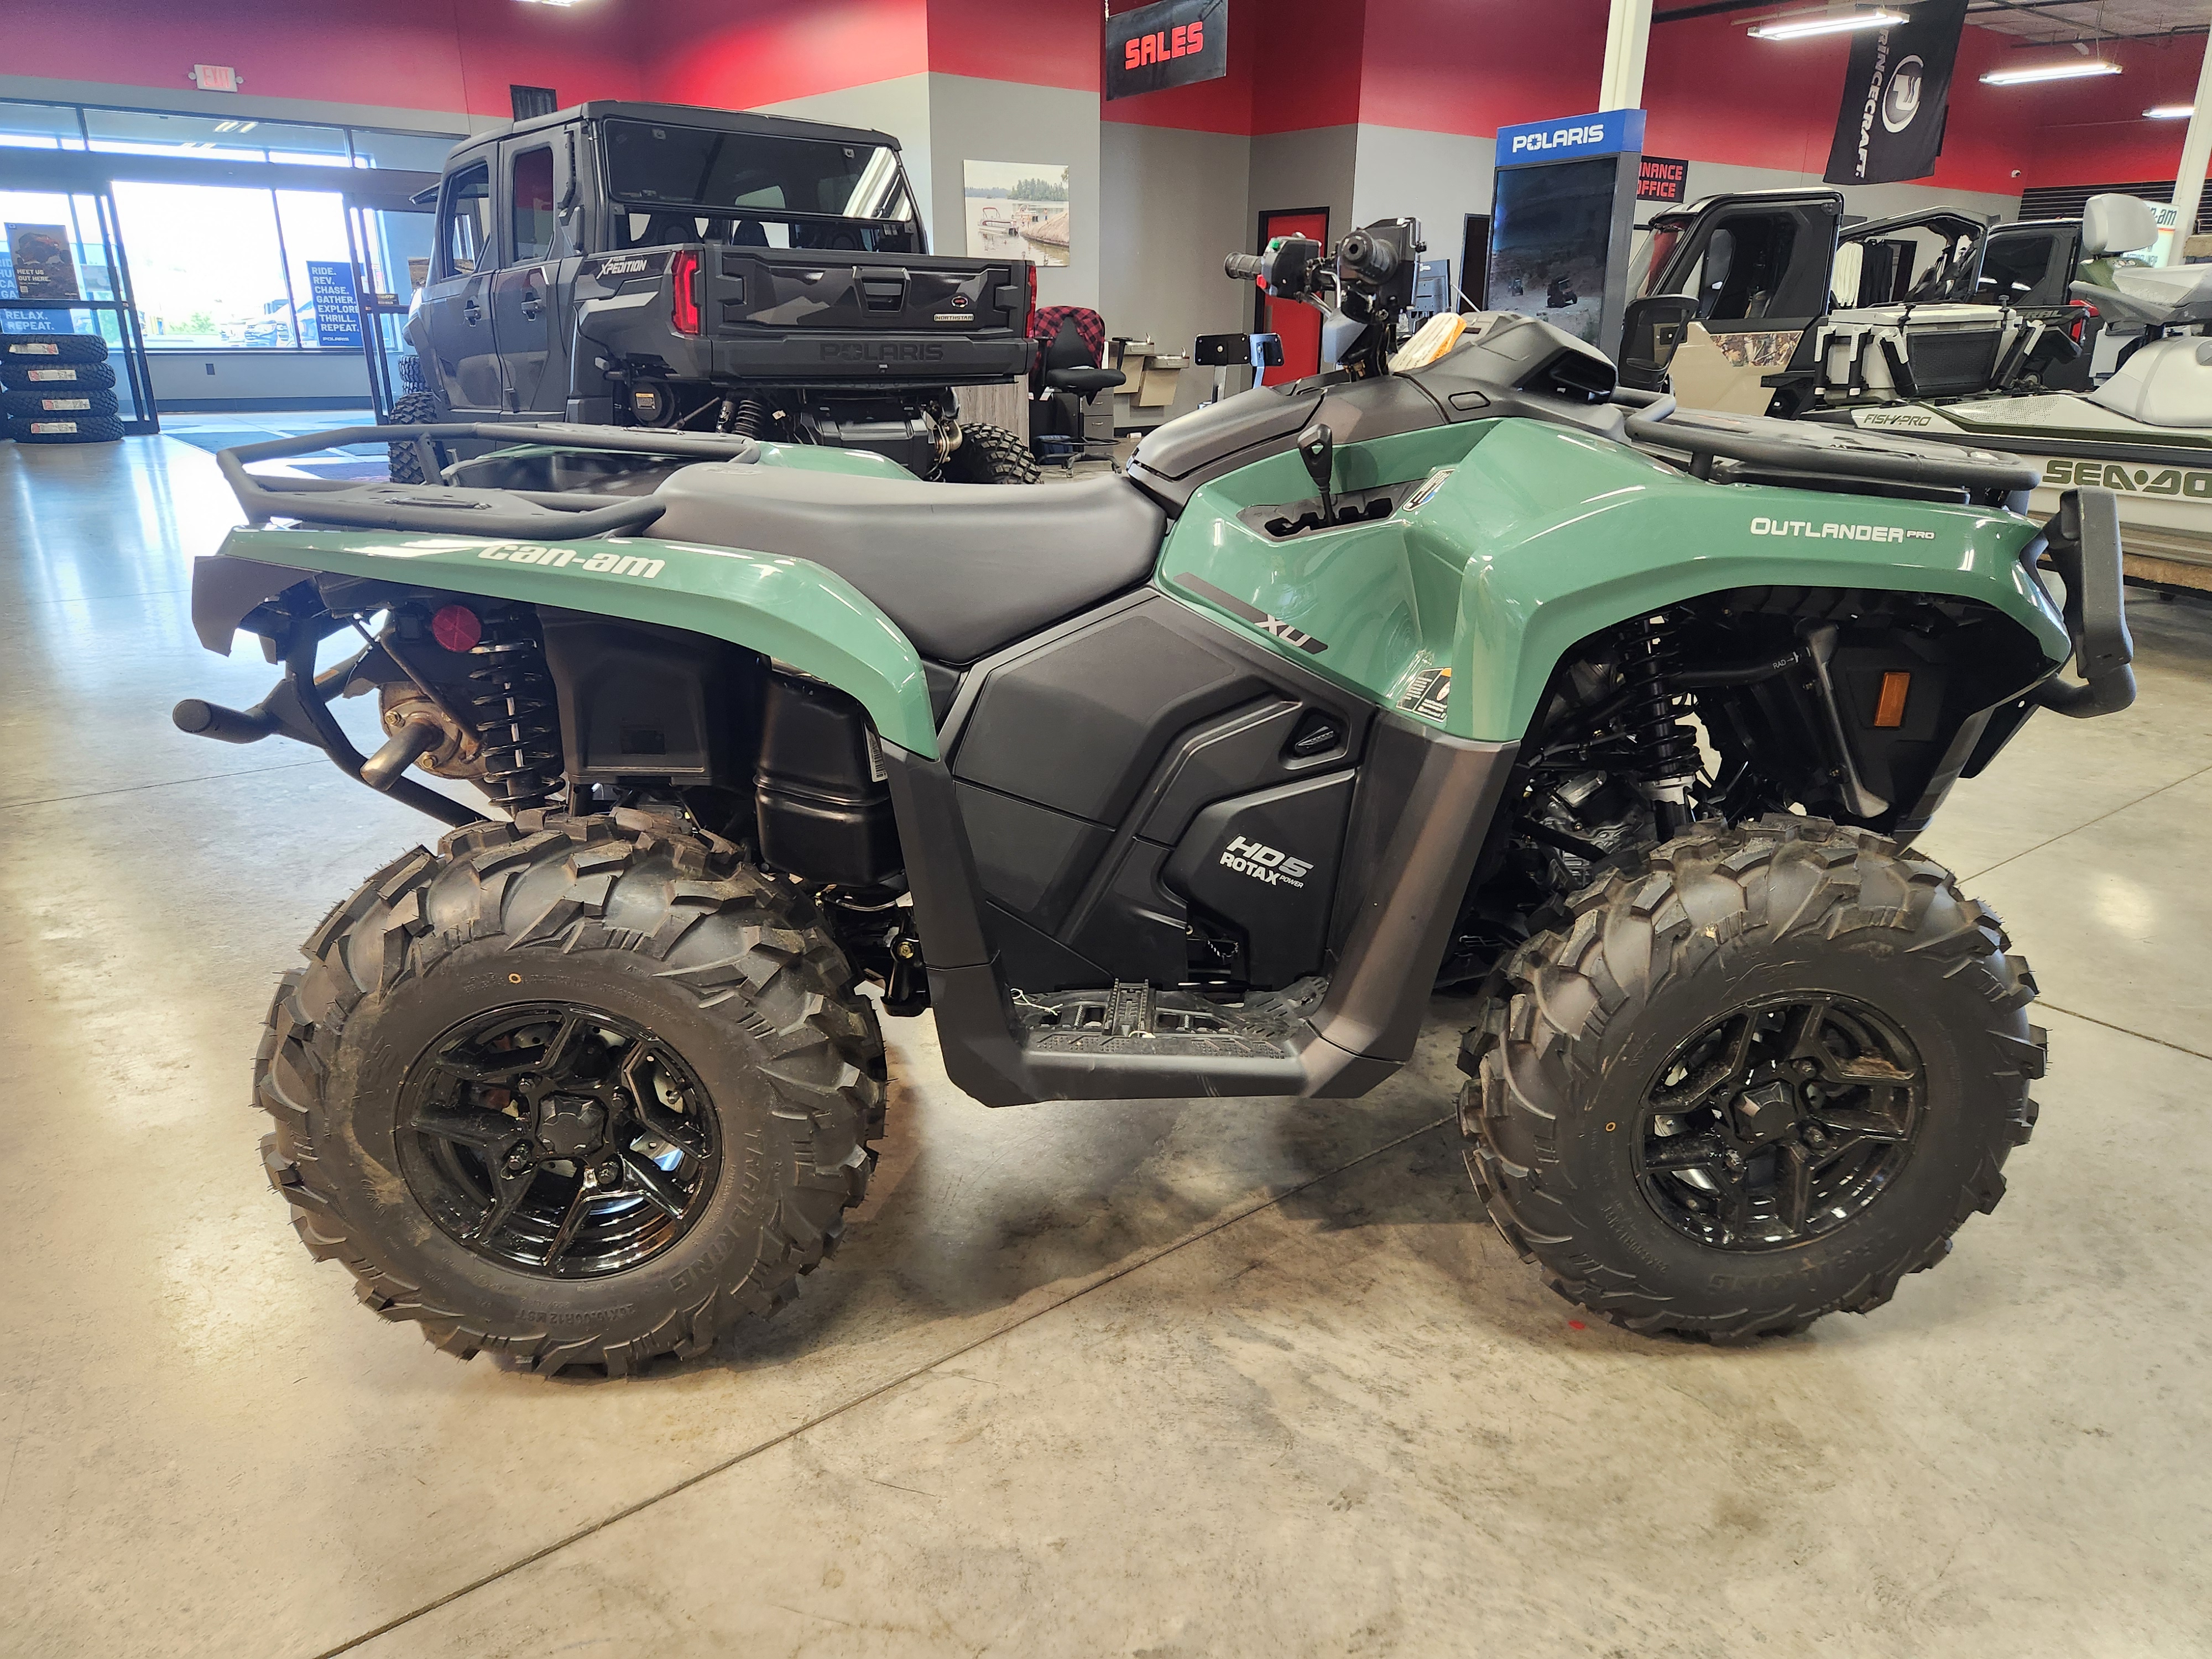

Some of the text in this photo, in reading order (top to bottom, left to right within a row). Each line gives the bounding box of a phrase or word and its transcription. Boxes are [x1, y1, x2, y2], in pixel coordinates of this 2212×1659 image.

[1125, 21, 1203, 70] SALES
[202, 66, 229, 88] EXIT
[1512, 124, 1604, 153] POLARIS
[1639, 162, 1683, 181] INANCE
[311, 267, 337, 275] RIDE.
[596, 258, 648, 279] XPEDITION
[313, 276, 336, 285] REV.
[315, 286, 349, 295] CHASE.
[316, 295, 356, 304] GATHER.
[6, 311, 48, 320] RELAX.
[319, 314, 356, 322] THRILL.
[8, 321, 54, 331] REPEAT.
[321, 324, 359, 332] REPEAT.
[819, 343, 943, 362] POLARIS
[1750, 518, 1935, 543] OUTLANDER PRO
[478, 545, 665, 579] can-am
[1772, 659, 1787, 670] RAD
[1220, 852, 1304, 889] ROTAX POWER
